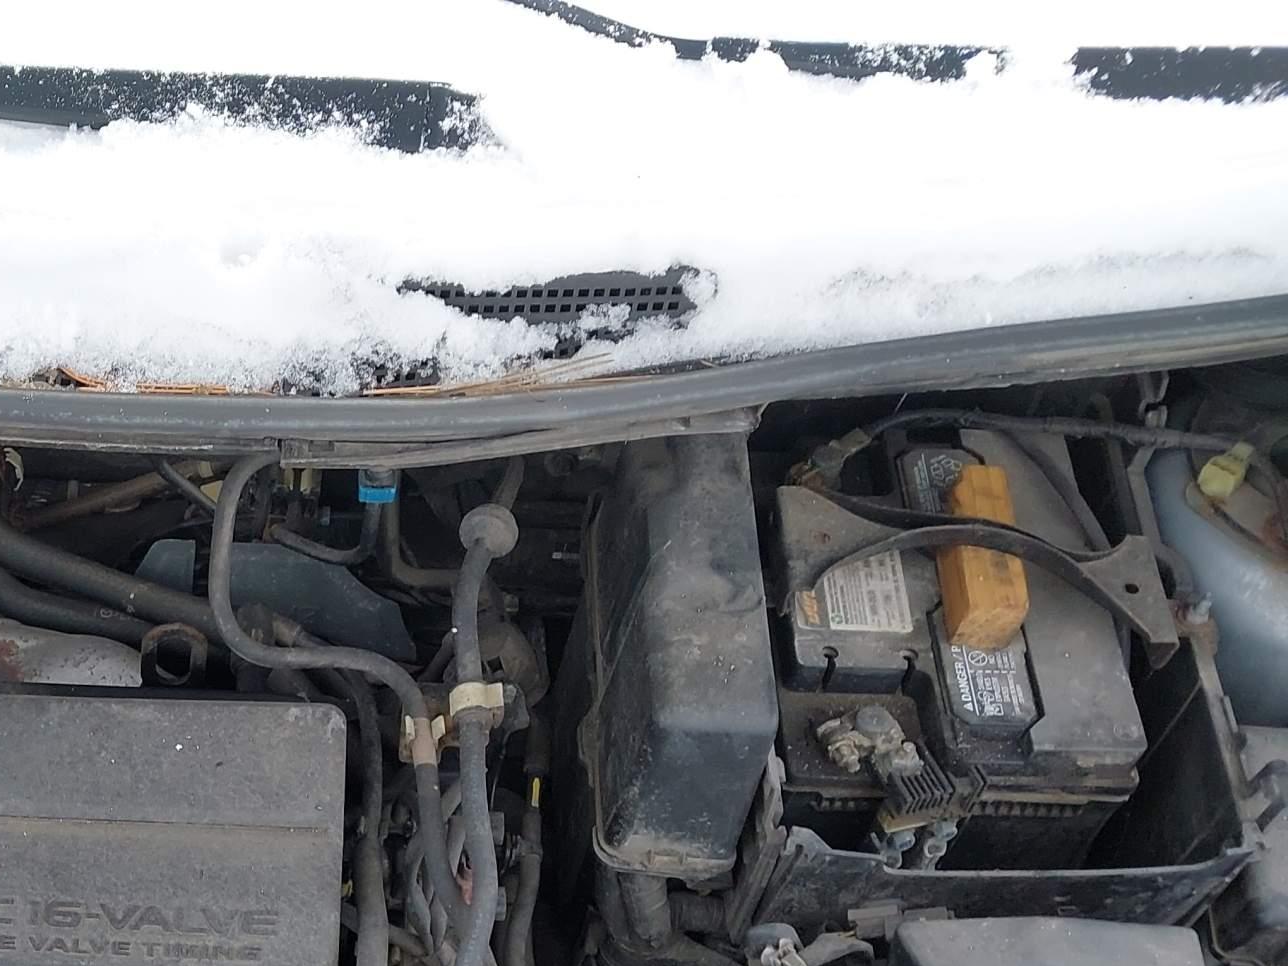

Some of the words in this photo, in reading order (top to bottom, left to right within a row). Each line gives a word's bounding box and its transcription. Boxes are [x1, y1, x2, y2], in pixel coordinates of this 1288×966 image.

[955, 661, 972, 702] DANGER
[30, 900, 280, 936] 16-VALVE
[28, 936, 131, 957] VALVE
[141, 941, 263, 962] TIMING
